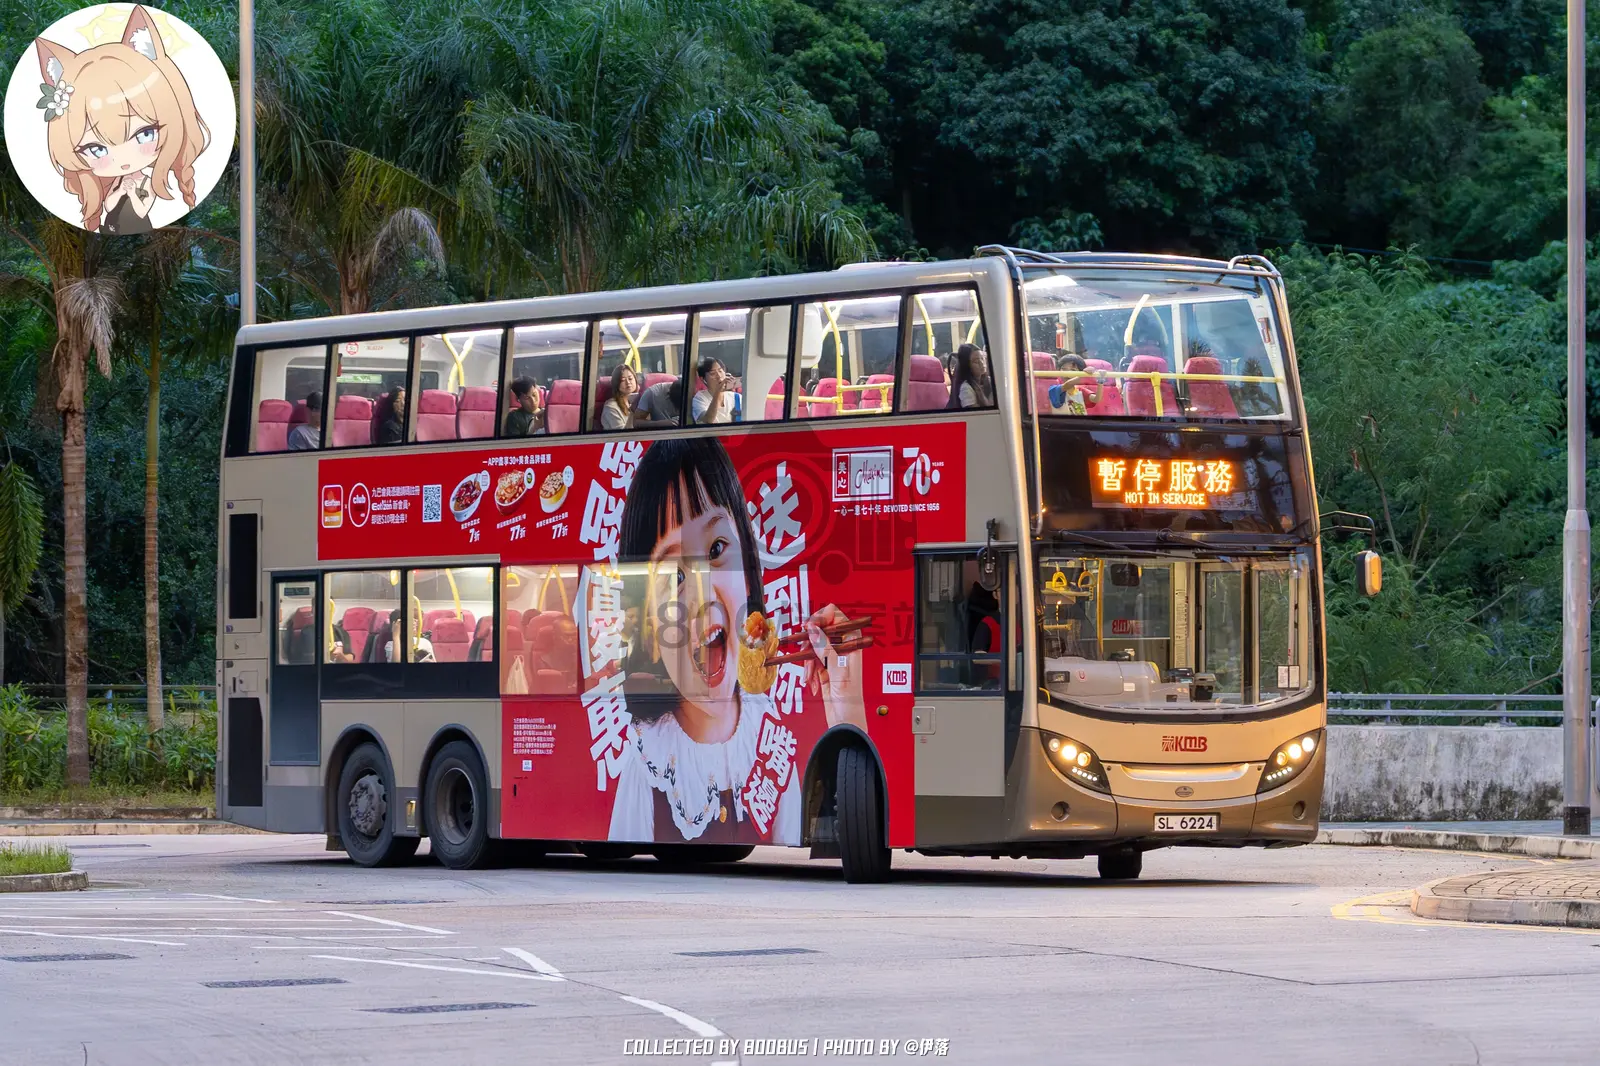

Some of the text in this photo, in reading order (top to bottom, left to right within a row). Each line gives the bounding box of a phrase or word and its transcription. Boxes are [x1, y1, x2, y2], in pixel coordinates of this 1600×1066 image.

[837, 461, 847, 489] 美心
[1097, 458, 1232, 493] 暫停服務
[1125, 492, 1206, 505] NOT IN SERVICE
[834, 503, 940, 516] 一心一意七十年 DEVOTED SINCE 1956
[469, 528, 480, 543] 7折
[509, 525, 526, 542] 77折
[552, 523, 569, 540] 77折
[886, 670, 908, 686] KMB
[1174, 735, 1208, 752] KMB
[1157, 816, 1214, 830] SL 6224
